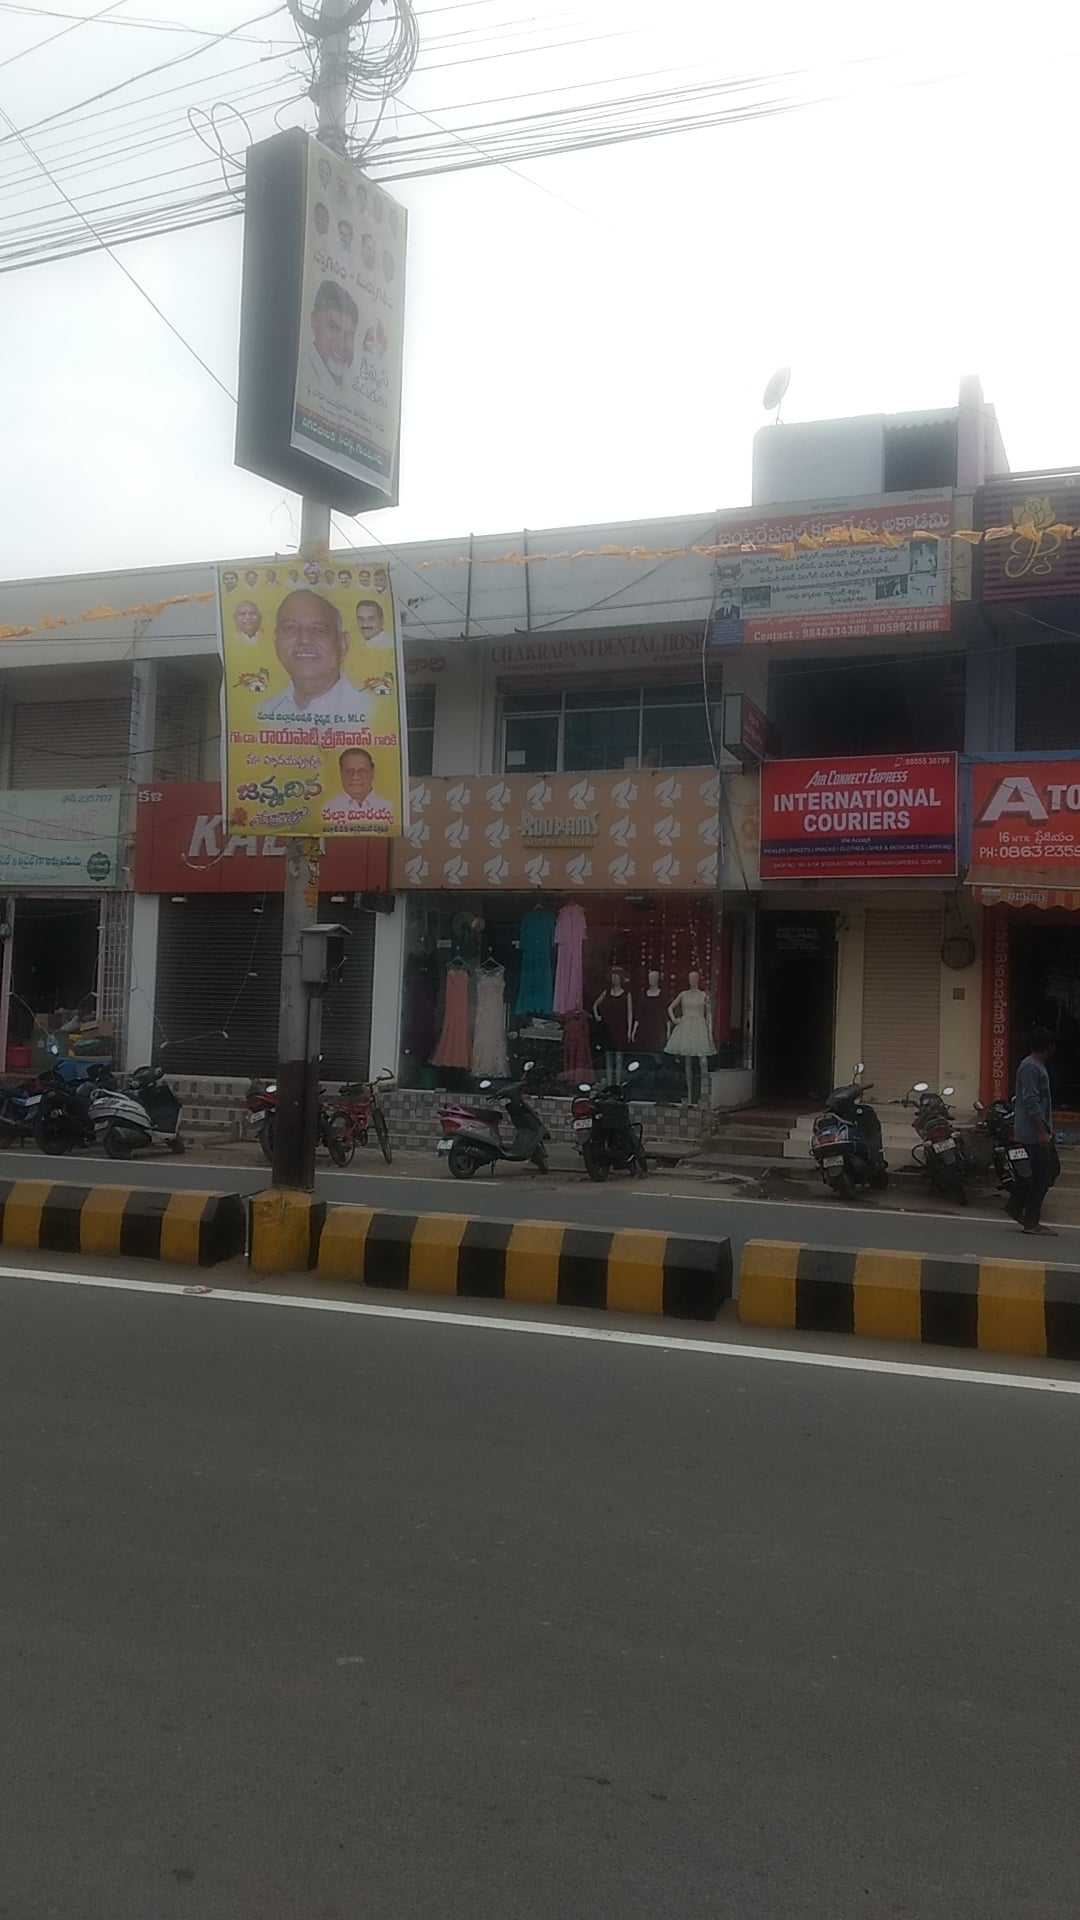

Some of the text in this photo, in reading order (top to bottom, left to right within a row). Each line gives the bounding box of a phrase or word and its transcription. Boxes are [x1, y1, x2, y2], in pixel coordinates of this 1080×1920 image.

[754, 629, 793, 641] Contact
[491, 640, 594, 663] CHAKRAPANI
[597, 635, 658, 656] DENTAL
[348, 712, 366, 723] MLC
[320, 726, 372, 749] శ్రీనివాస్
[773, 788, 942, 812] INTERNATIONAL
[803, 810, 911, 833] COURIERS
[999, 831, 1009, 843] 16
[1011, 834, 1031, 843] NTR
[999, 845, 1043, 858] 0863
